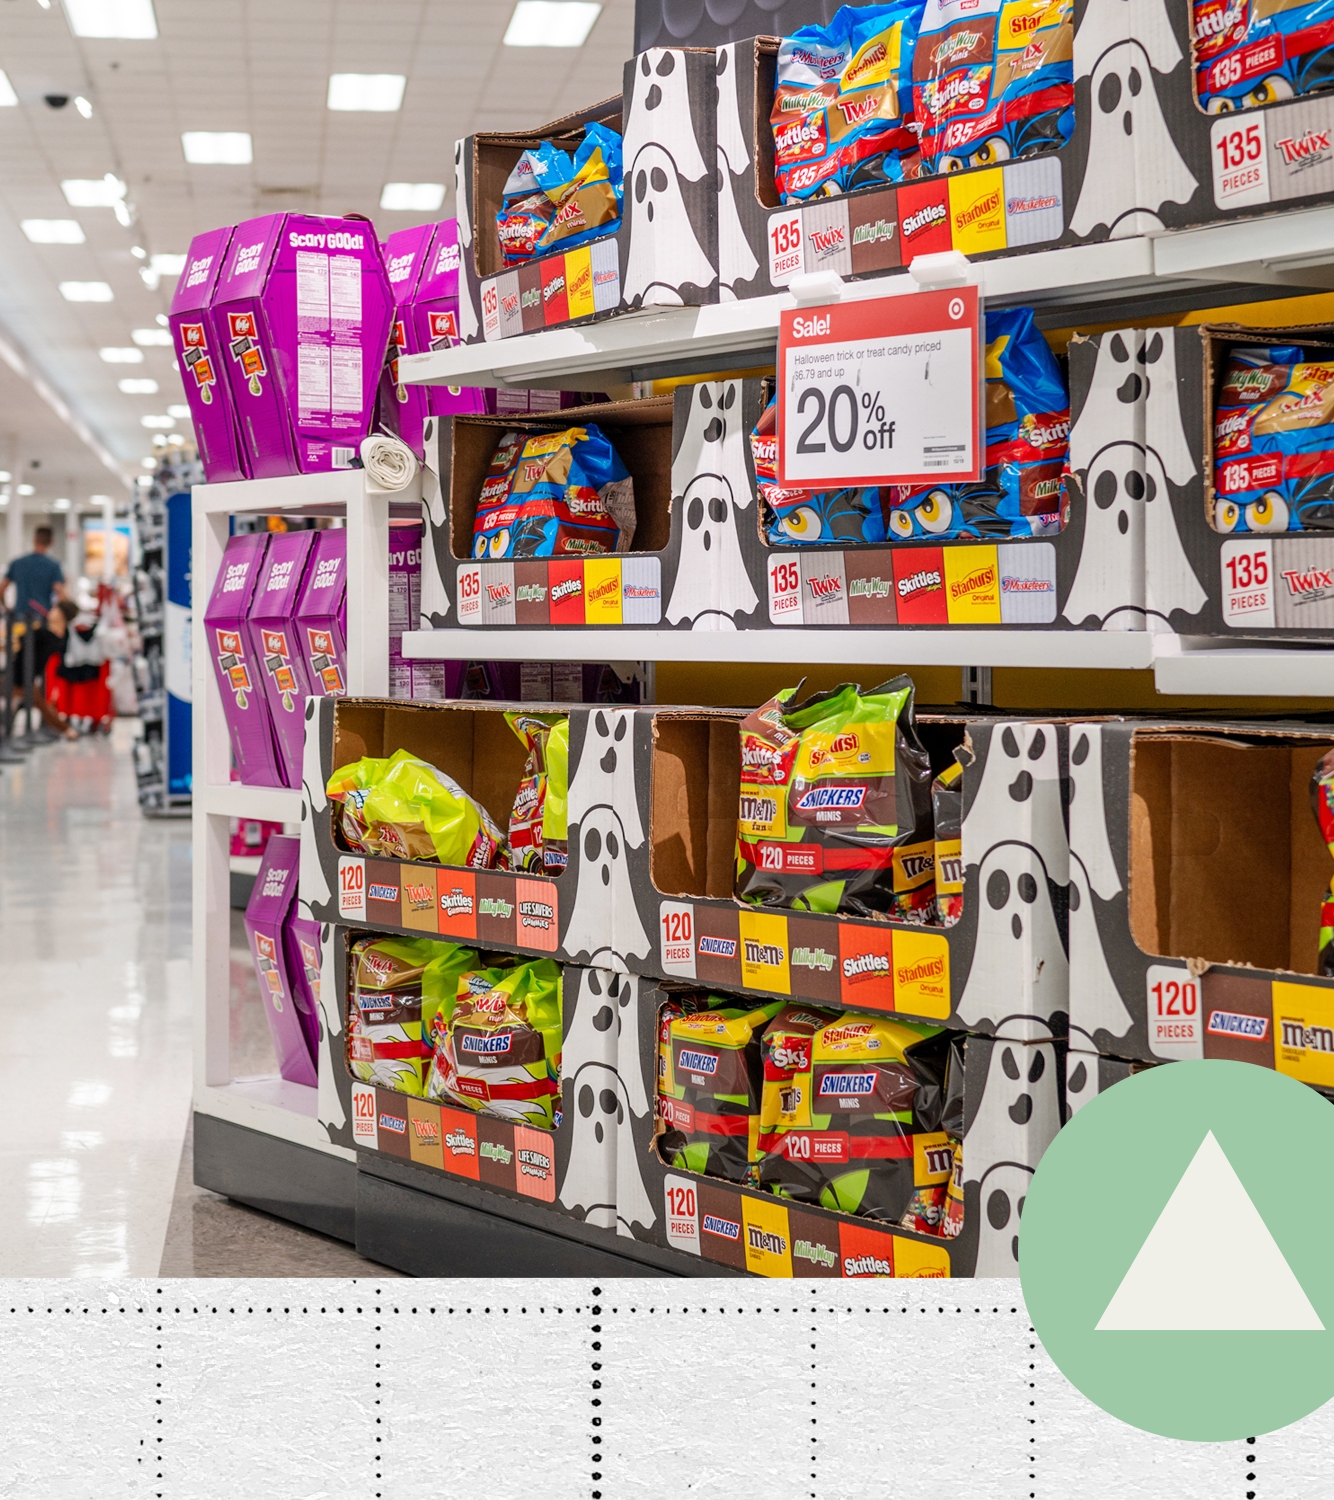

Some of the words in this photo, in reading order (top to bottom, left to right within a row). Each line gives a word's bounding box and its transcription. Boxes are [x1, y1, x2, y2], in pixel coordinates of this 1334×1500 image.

[1246, 47, 1276, 68] PIECES
[1212, 53, 1241, 88] 135
[946, 120, 975, 145] 135
[1216, 124, 1262, 171] 135
[791, 166, 816, 192] 135
[1221, 168, 1261, 193] PIECES
[955, 189, 1000, 229] Starburst
[902, 203, 946, 236] Skittles
[978, 219, 1000, 229] Original
[289, 232, 326, 249] Scary
[771, 219, 801, 255] 135
[238, 242, 264, 261] Scary
[190, 256, 213, 273] Scary
[774, 255, 800, 273] PIECES
[544, 275, 565, 301] Skittles
[482, 286, 498, 315] 135
[792, 314, 831, 338] Sale!
[794, 352, 834, 366] Halloween
[837, 350, 854, 362] trick
[856, 351, 865, 360] or
[867, 346, 886, 358] treat
[888, 344, 912, 360] candy
[915, 340, 942, 355] priced
[794, 369, 815, 382] $6.79
[818, 368, 832, 378] and
[834, 368, 845, 380] up
[1239, 391, 1260, 400] minis
[863, 422, 896, 450] off
[1223, 463, 1249, 491] 135
[1252, 464, 1277, 479] PIECES
[483, 513, 498, 528] 135
[498, 509, 517, 522] PIECES
[227, 562, 249, 579] Scary
[270, 560, 294, 577] Scary
[317, 558, 340, 573] Scary
[1226, 551, 1269, 590] 135
[459, 571, 479, 599] 135
[770, 562, 799, 594] 135
[898, 570, 941, 599] Skittles
[951, 567, 994, 601] Starburst
[551, 578, 582, 600] Skittles
[588, 577, 619, 604] Starburst
[972, 594, 994, 602] Original
[460, 600, 479, 613] PIECES
[774, 596, 798, 611] PIECES
[1230, 593, 1267, 611] PIECES
[801, 788, 864, 808] SNICKERS
[751, 820, 767, 831] fun
[760, 846, 783, 870] 120
[787, 854, 814, 865] PIECES
[266, 868, 289, 883] Scary
[340, 864, 363, 891] 120
[342, 894, 362, 907] PIECES
[369, 884, 398, 901] SNICKERS
[441, 894, 473, 908] Skittles
[662, 913, 692, 942] 120
[666, 947, 690, 959] PIECES
[699, 937, 736, 955] SNICKERS
[843, 954, 889, 977] Skittles
[898, 959, 944, 984] Starburst
[920, 984, 944, 994] Original
[1151, 982, 1197, 1016] 120
[822, 1023, 875, 1045] Starburst
[1156, 1023, 1194, 1039] PIECES
[1210, 1014, 1266, 1036] SNICKERS
[463, 1035, 511, 1052] SNICKERS
[680, 1050, 718, 1073] SNICKERS
[461, 1084, 483, 1094] PIECES
[821, 1074, 876, 1093] SNICKERS
[353, 1093, 375, 1118] 120
[379, 1114, 406, 1132] SNICKERS
[675, 1110, 690, 1123] PIECES
[355, 1121, 374, 1133] PIECES
[446, 1133, 475, 1149] Skittles
[785, 1136, 810, 1158] 120
[815, 1142, 842, 1153] PIECES
[667, 1188, 696, 1216] 120
[671, 1222, 695, 1235] PIECES
[704, 1217, 739, 1238] SNICKERS
[845, 1256, 890, 1278] Skittles
